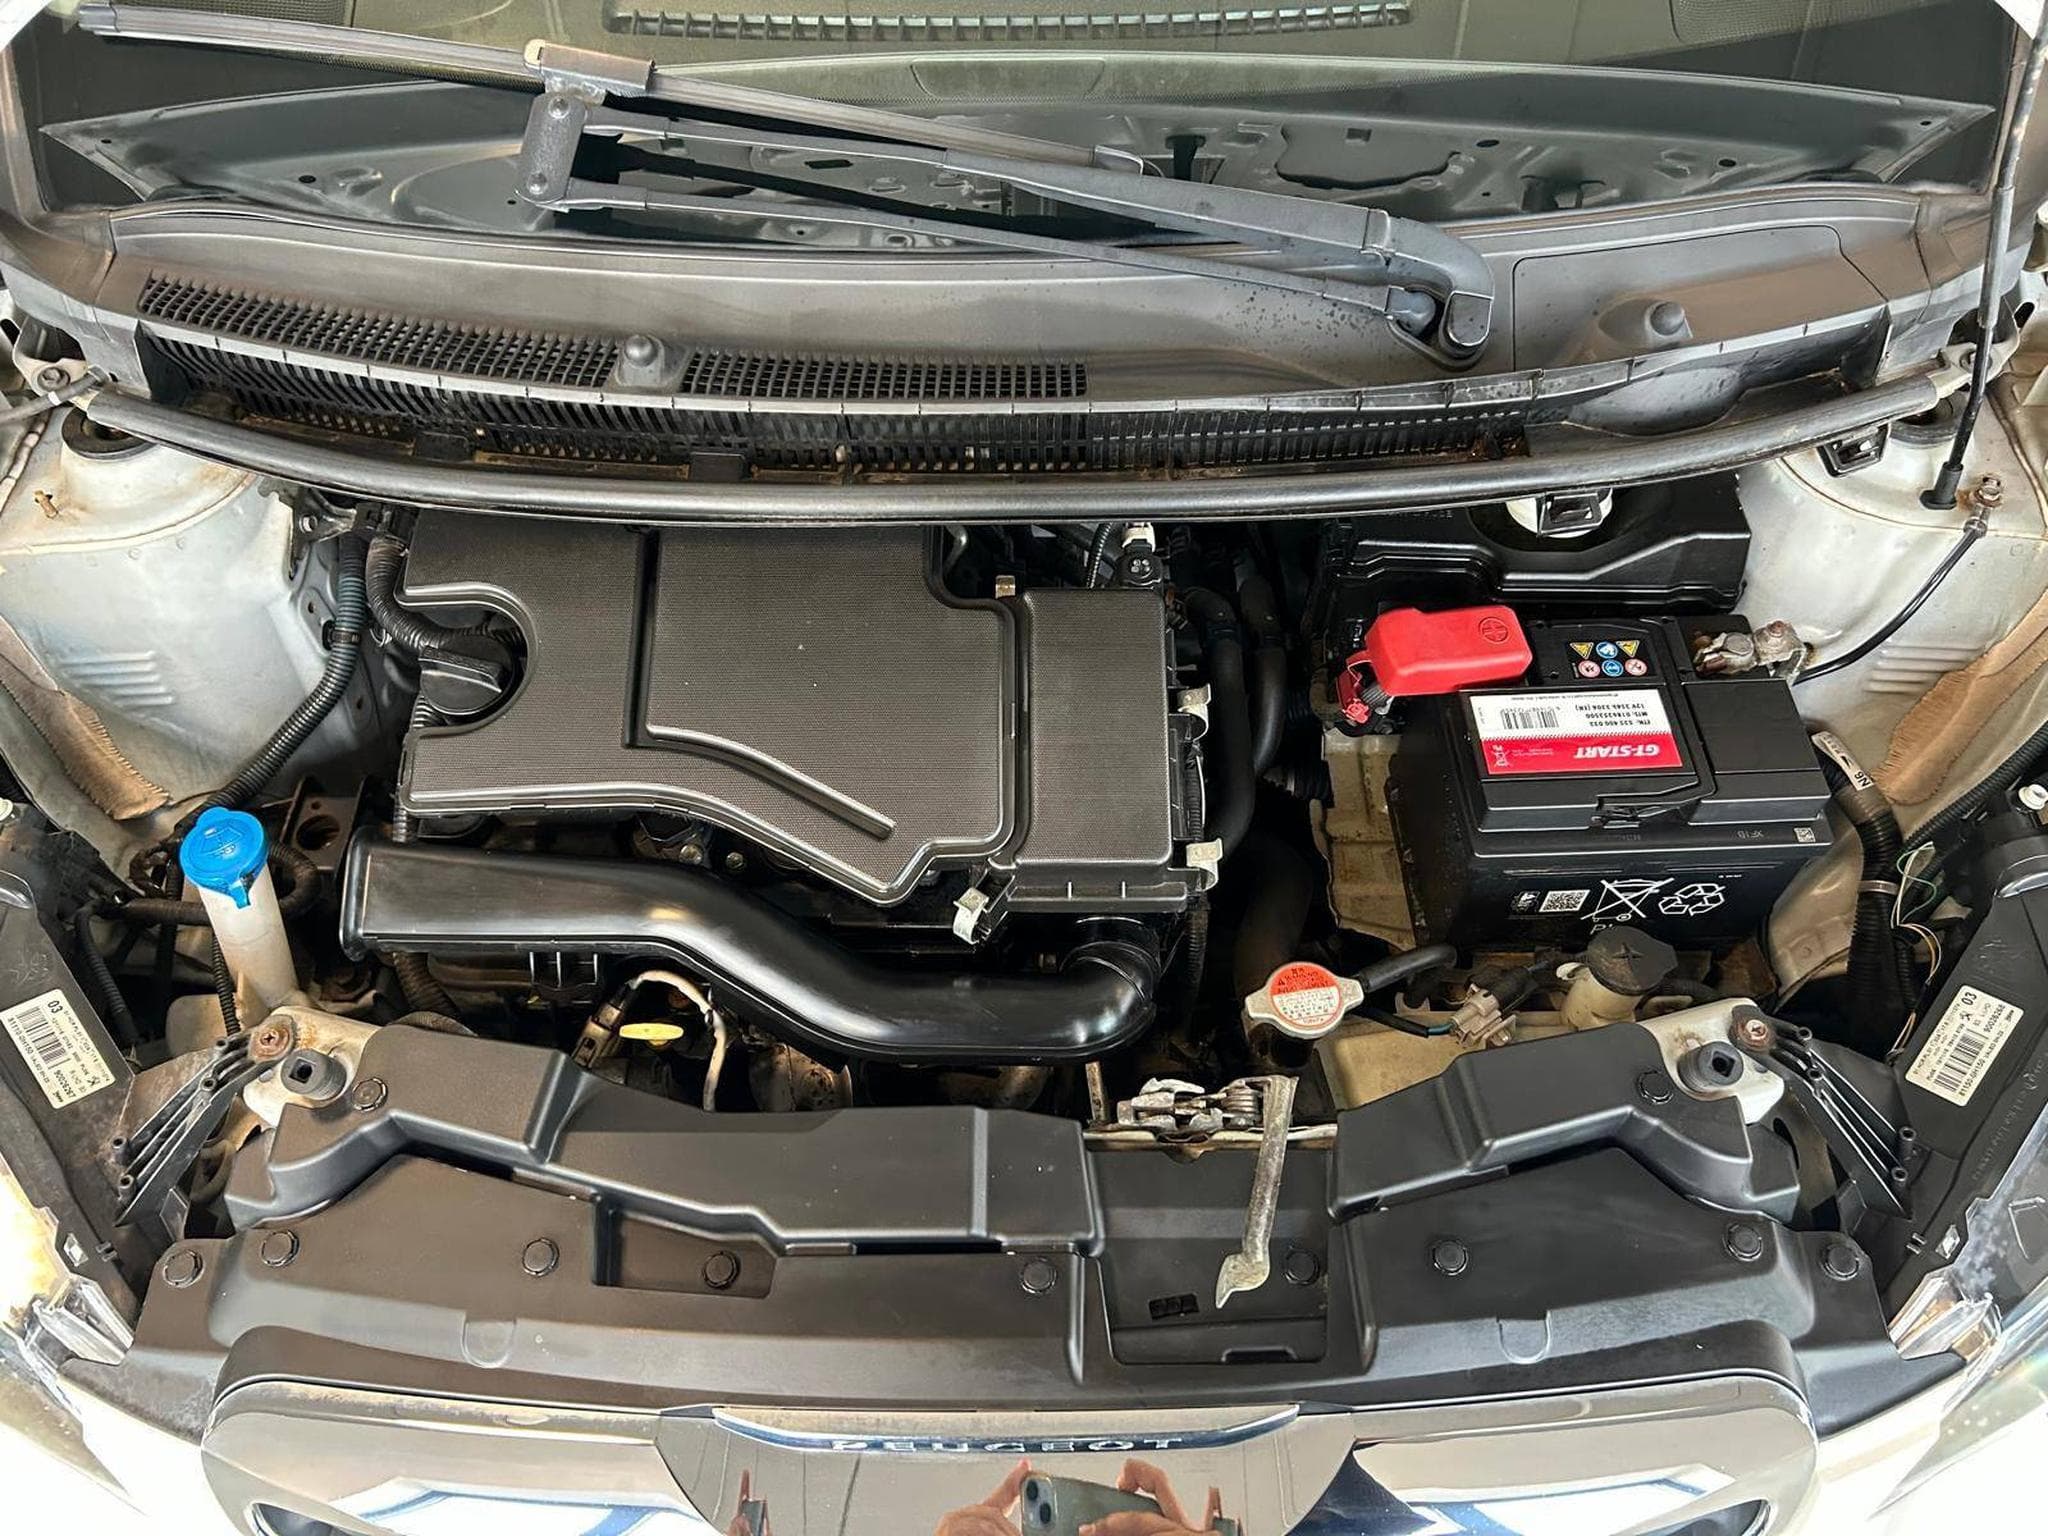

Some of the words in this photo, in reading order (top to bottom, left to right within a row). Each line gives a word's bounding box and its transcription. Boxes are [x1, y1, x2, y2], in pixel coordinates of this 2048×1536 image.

[1574, 743, 1661, 758] GT-START
[1961, 992, 1977, 1006] 03
[47, 1000, 64, 1014] 03
[831, 1437, 1182, 1453] PEUGEOT
